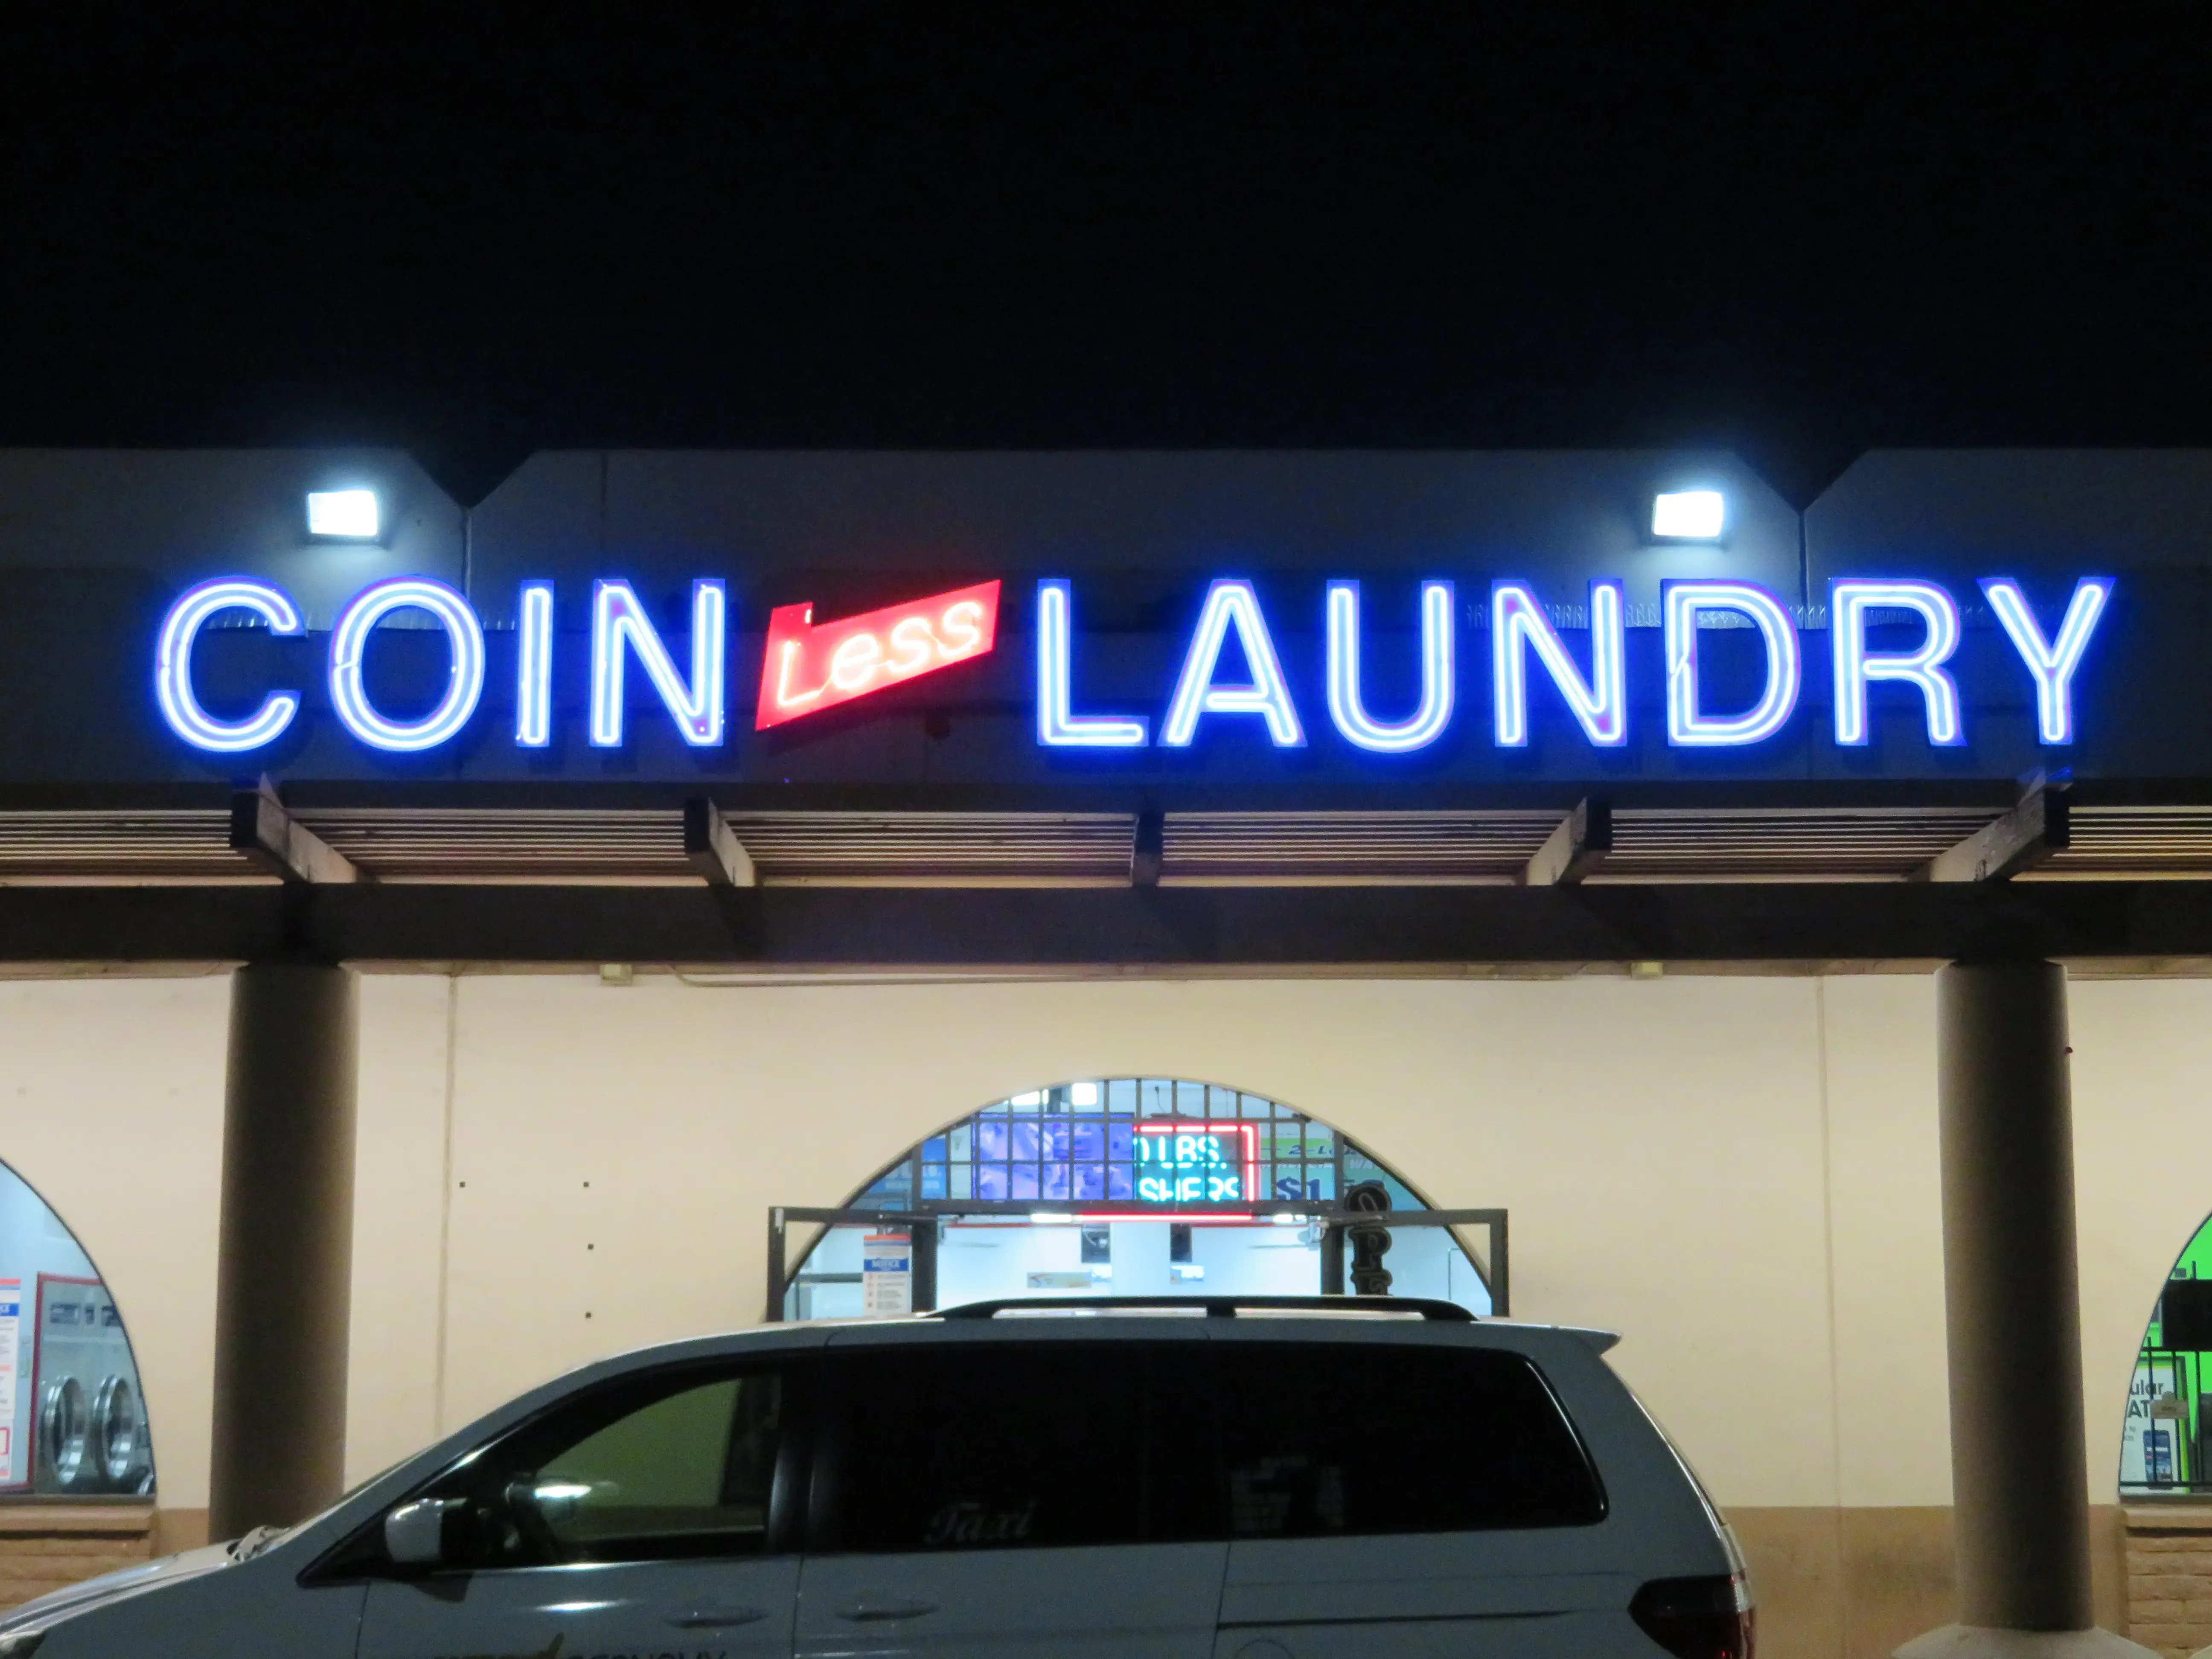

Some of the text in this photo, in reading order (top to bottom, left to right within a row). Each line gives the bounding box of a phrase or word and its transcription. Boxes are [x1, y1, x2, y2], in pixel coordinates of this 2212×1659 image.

[155, 575, 2116, 753] COIN Less LAUNDRY
[924, 1500, 1039, 1545] Taxi
